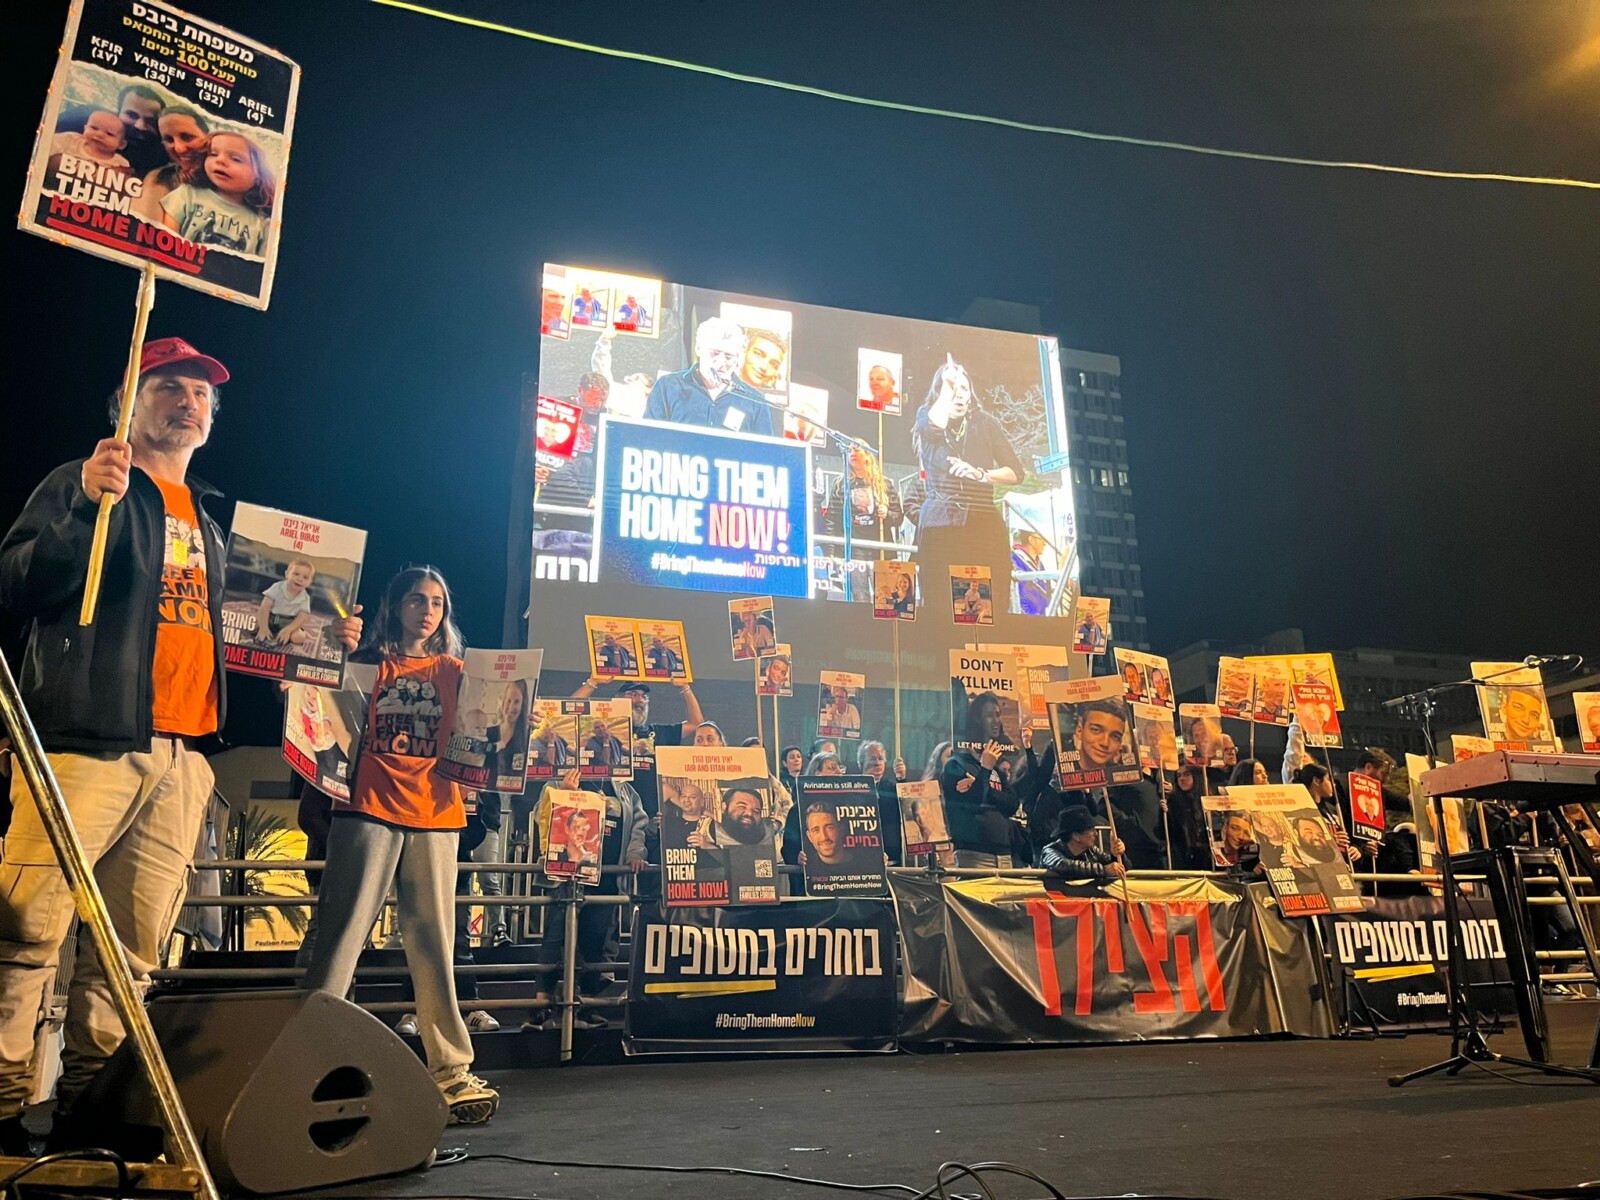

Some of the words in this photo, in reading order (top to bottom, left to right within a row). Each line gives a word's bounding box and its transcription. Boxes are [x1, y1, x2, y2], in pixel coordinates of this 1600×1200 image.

[132, 2, 178, 33] ביבס
[122, 16, 171, 44] החמאס
[141, 37, 175, 57] ימים!
[173, 35, 205, 59] בשבי
[182, 18, 254, 63] משפחת
[177, 51, 209, 72] 100
[207, 50, 257, 79] מוחזקים
[90, 35, 124, 56] KFIR
[134, 52, 186, 81] YARDEN
[195, 77, 231, 99] SHIRI
[238, 96, 275, 118] ARIEL
[211, 65, 236, 84] מעל
[91, 48, 118, 67] (1Y)
[145, 68, 171, 87] (34)
[198, 88, 225, 109] (32)
[246, 108, 265, 125] (4)
[58, 153, 144, 200] BRING
[55, 173, 132, 215] THEM
[50, 194, 131, 239] HOME
[136, 222, 207, 265] NOW!
[622, 446, 709, 499] BRING
[713, 458, 790, 509] THEM
[619, 492, 704, 545] HOME
[708, 503, 790, 554] NOW!
[280, 528, 298, 539] ARIEL
[300, 532, 320, 544] BIBAS
[294, 540, 303, 551] (4)
[158, 599, 213, 631] NO
[250, 651, 287, 671] NOW!
[961, 658, 1004, 673] DON'T
[1028, 669, 1050, 682] BRING
[376, 714, 414, 726] FREE
[371, 736, 437, 757] NOW
[957, 741, 970, 749] LET
[971, 742, 982, 750] ME
[1059, 750, 1080, 762] BRING
[463, 766, 490, 784] NOW!
[697, 764, 709, 772] AND
[710, 764, 726, 772] EITAN
[1060, 762, 1075, 773] HIM
[841, 781, 853, 789] still
[1062, 772, 1083, 786] HOME
[1084, 769, 1106, 783] NOW!
[836, 806, 876, 821] אבינתן
[848, 820, 878, 835] עדיין
[843, 836, 881, 848] בחיים.
[665, 848, 698, 865] BRING
[665, 864, 696, 881] THEM
[1269, 867, 1295, 881] BRING
[667, 882, 697, 899] HOME
[698, 880, 729, 898] NOW!
[813, 882, 882, 891] #BringThemHomeNow
[1274, 880, 1299, 895] THEM
[1281, 895, 1306, 910] HOME
[1303, 891, 1328, 909] NOW!
[280, 939, 301, 947] Family
[1334, 920, 1433, 963] בחטופים
[1432, 919, 1506, 961] בוחרם
[644, 924, 777, 976] בחטופים
[785, 928, 883, 976] בוחרים
[1025, 890, 1227, 1016] הצילו
[715, 1012, 816, 1031] #BringThemHomeNow
